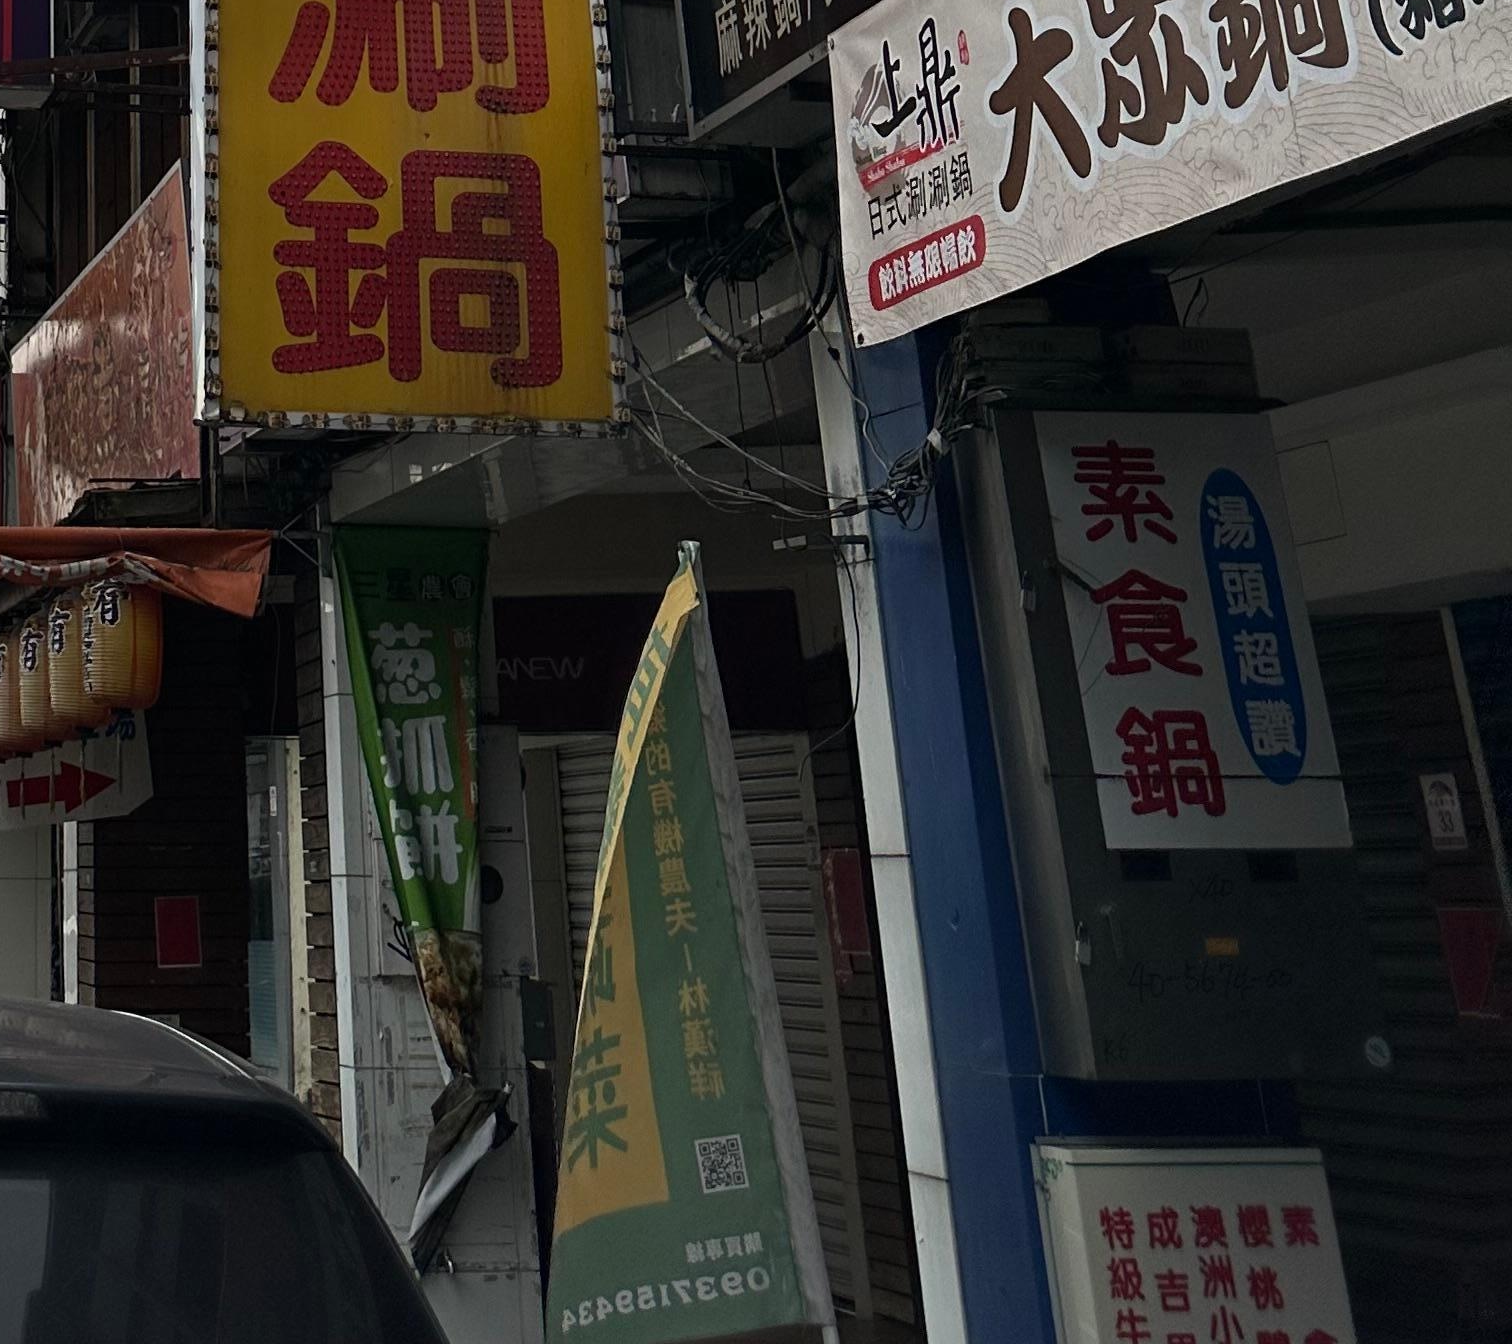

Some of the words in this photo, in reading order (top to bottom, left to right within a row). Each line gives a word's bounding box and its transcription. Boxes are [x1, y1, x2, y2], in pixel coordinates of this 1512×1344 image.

[871, 17, 960, 152] 上鼎
[868, 152, 974, 240] 日式涮涮鍋
[878, 224, 978, 302] 飲料無限暢飲
[495, 656, 585, 681] ANEW
[1071, 439, 1226, 818] 素食鍋
[1206, 494, 1302, 758] 湯頭超讚
[1099, 1205, 1152, 1344] 特級牛
[1190, 1204, 1245, 1344] 澳洲小
